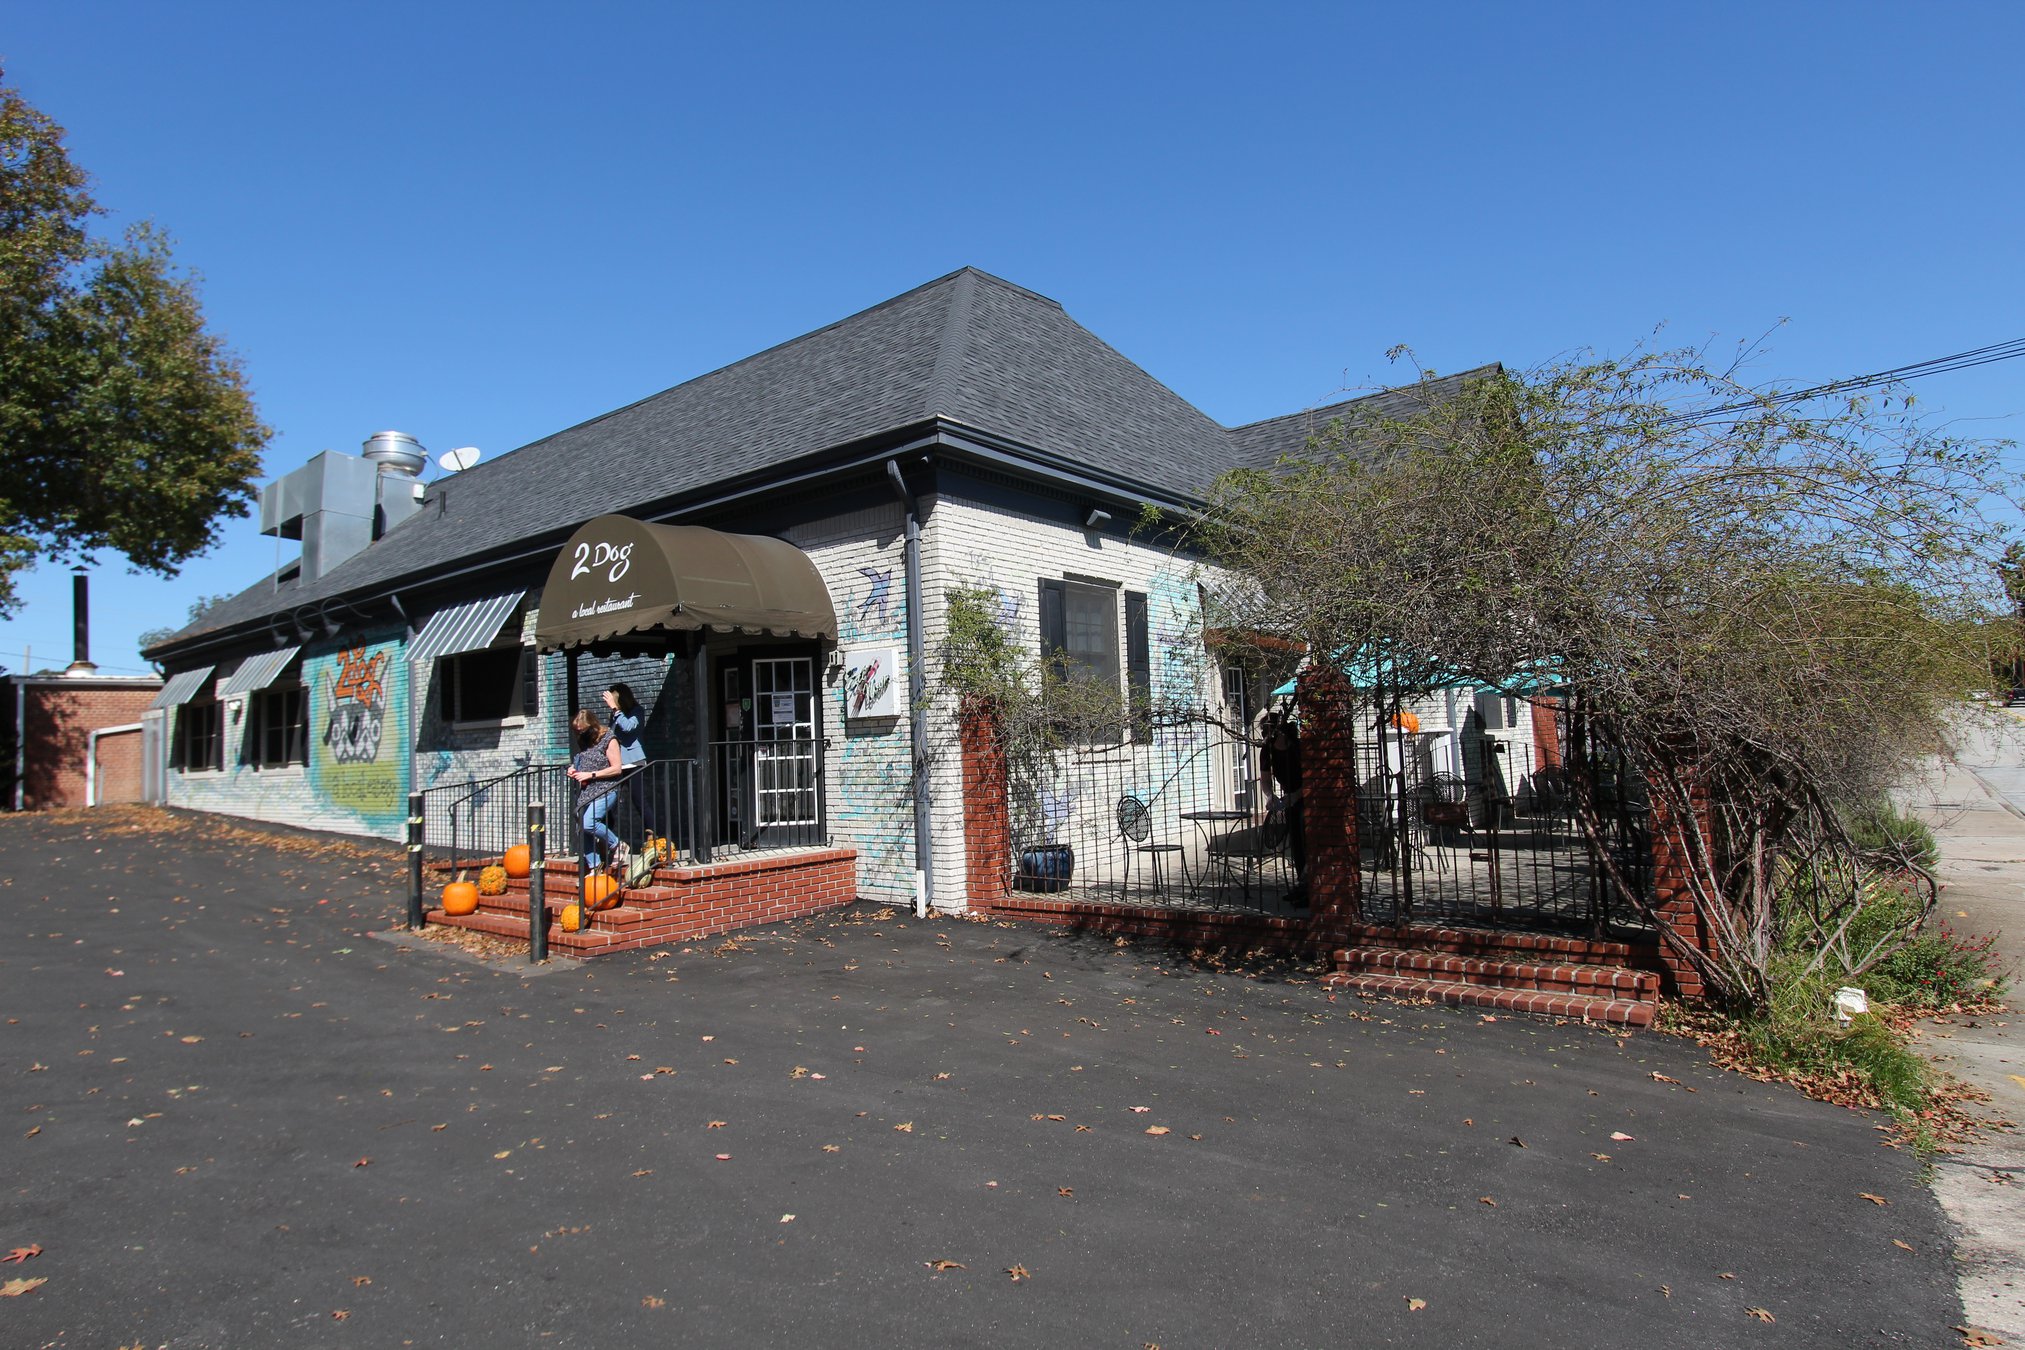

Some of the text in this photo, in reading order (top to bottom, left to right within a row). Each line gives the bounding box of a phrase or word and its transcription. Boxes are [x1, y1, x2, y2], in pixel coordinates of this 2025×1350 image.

[571, 542, 634, 582] 2 Dog
[571, 592, 641, 618] a local restaurant
